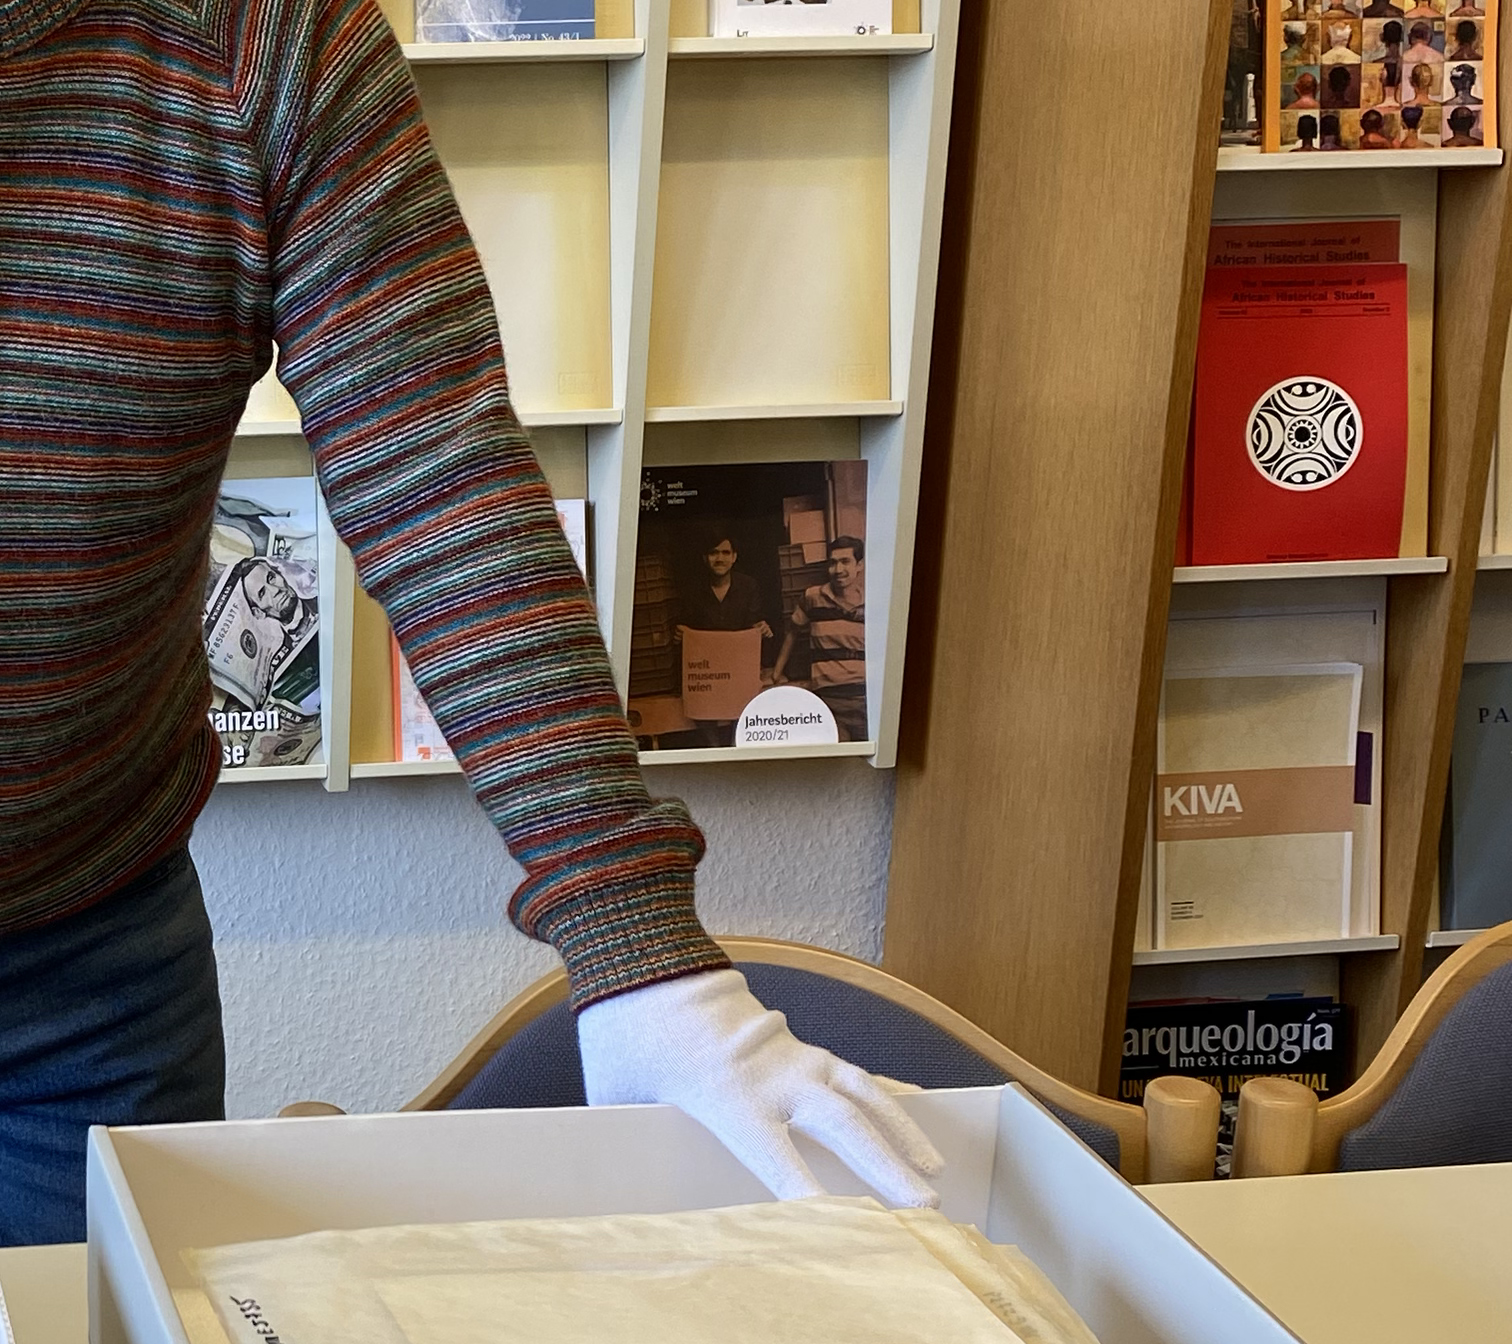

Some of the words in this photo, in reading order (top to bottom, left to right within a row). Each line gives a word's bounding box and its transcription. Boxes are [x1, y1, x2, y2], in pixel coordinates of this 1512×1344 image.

[1214, 255, 1257, 266] African
[1263, 253, 1319, 264] Historical
[1326, 250, 1369, 262] Studies
[1232, 292, 1270, 302] African
[1276, 291, 1328, 301] Historical
[1334, 290, 1375, 300] Studies
[688, 659, 710, 669] welt
[688, 671, 730, 680] museum
[688, 682, 711, 692] wien
[745, 713, 822, 729] Jahresbericht
[745, 729, 789, 742] 2020/21
[1164, 784, 1243, 817] KIVA
[1122, 1010, 1333, 1068] arqueología
[1179, 1052, 1276, 1068] mexicana
